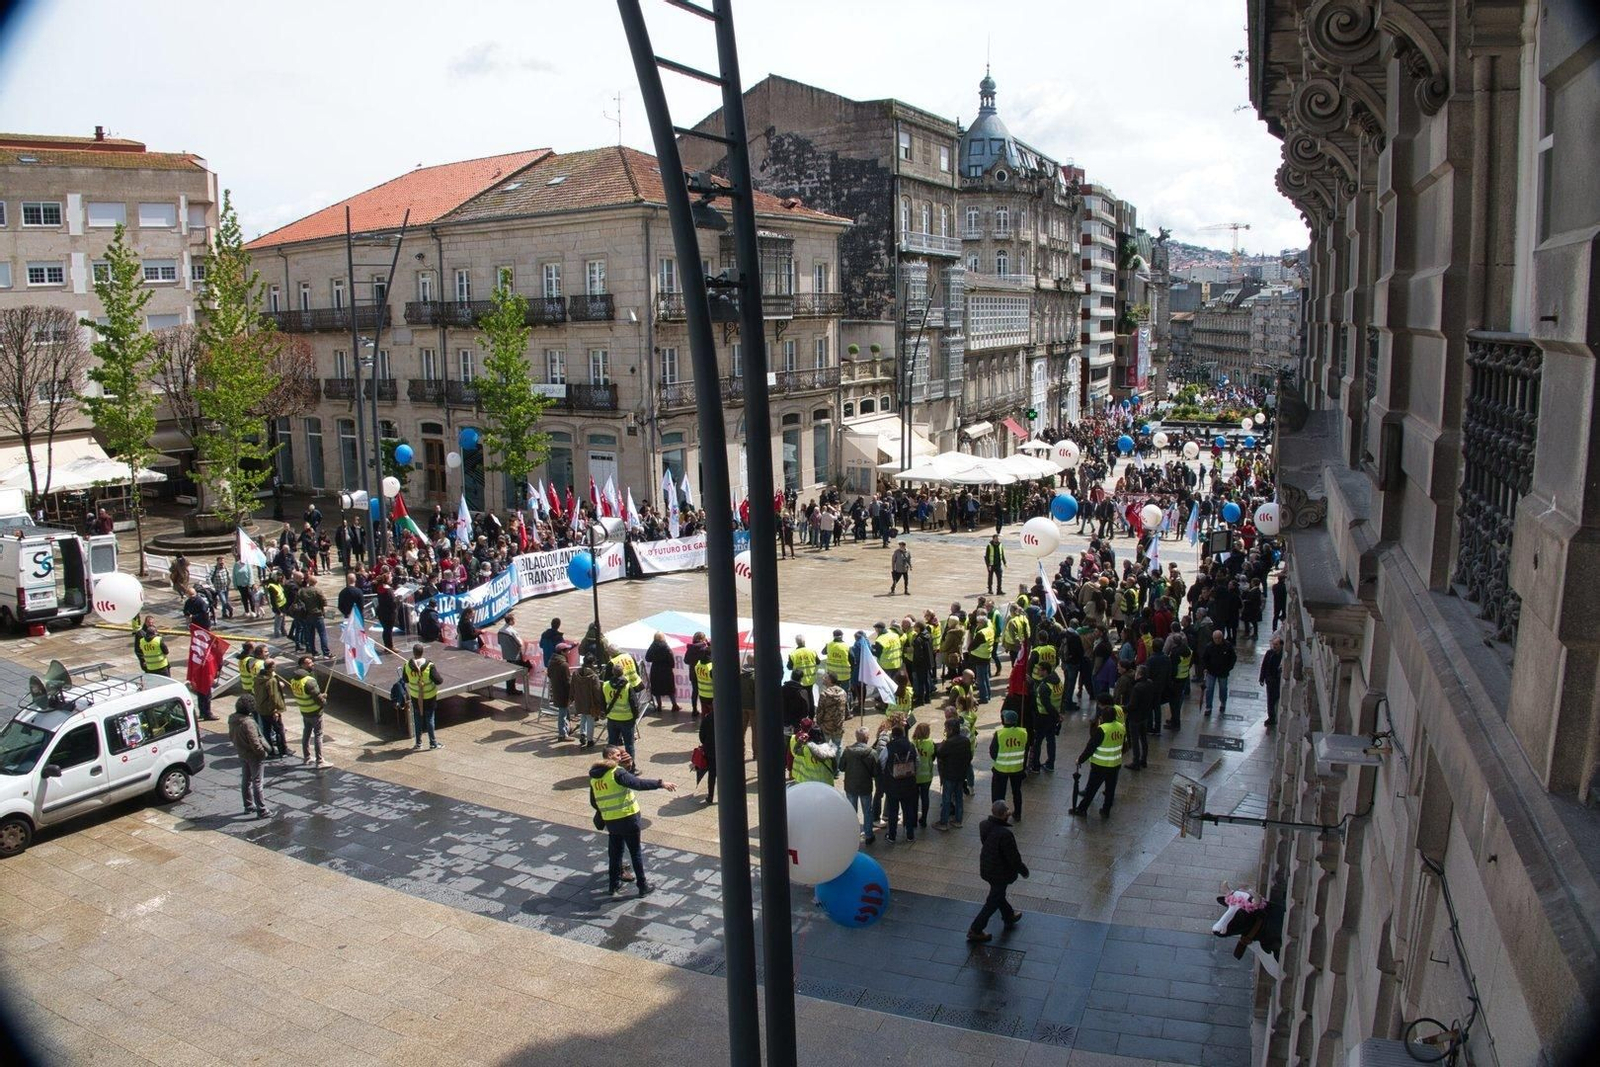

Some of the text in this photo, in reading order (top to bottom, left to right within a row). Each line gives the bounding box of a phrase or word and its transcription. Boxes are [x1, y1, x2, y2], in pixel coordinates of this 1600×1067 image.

[1023, 534, 1039, 546] CIG
[654, 546, 681, 556] FUTURO
[682, 543, 692, 552] DE
[519, 551, 558, 574] BILACION
[524, 566, 569, 588] TRANSPORT
[97, 601, 116, 612] CIG
[1006, 737, 1021, 748] CIG
